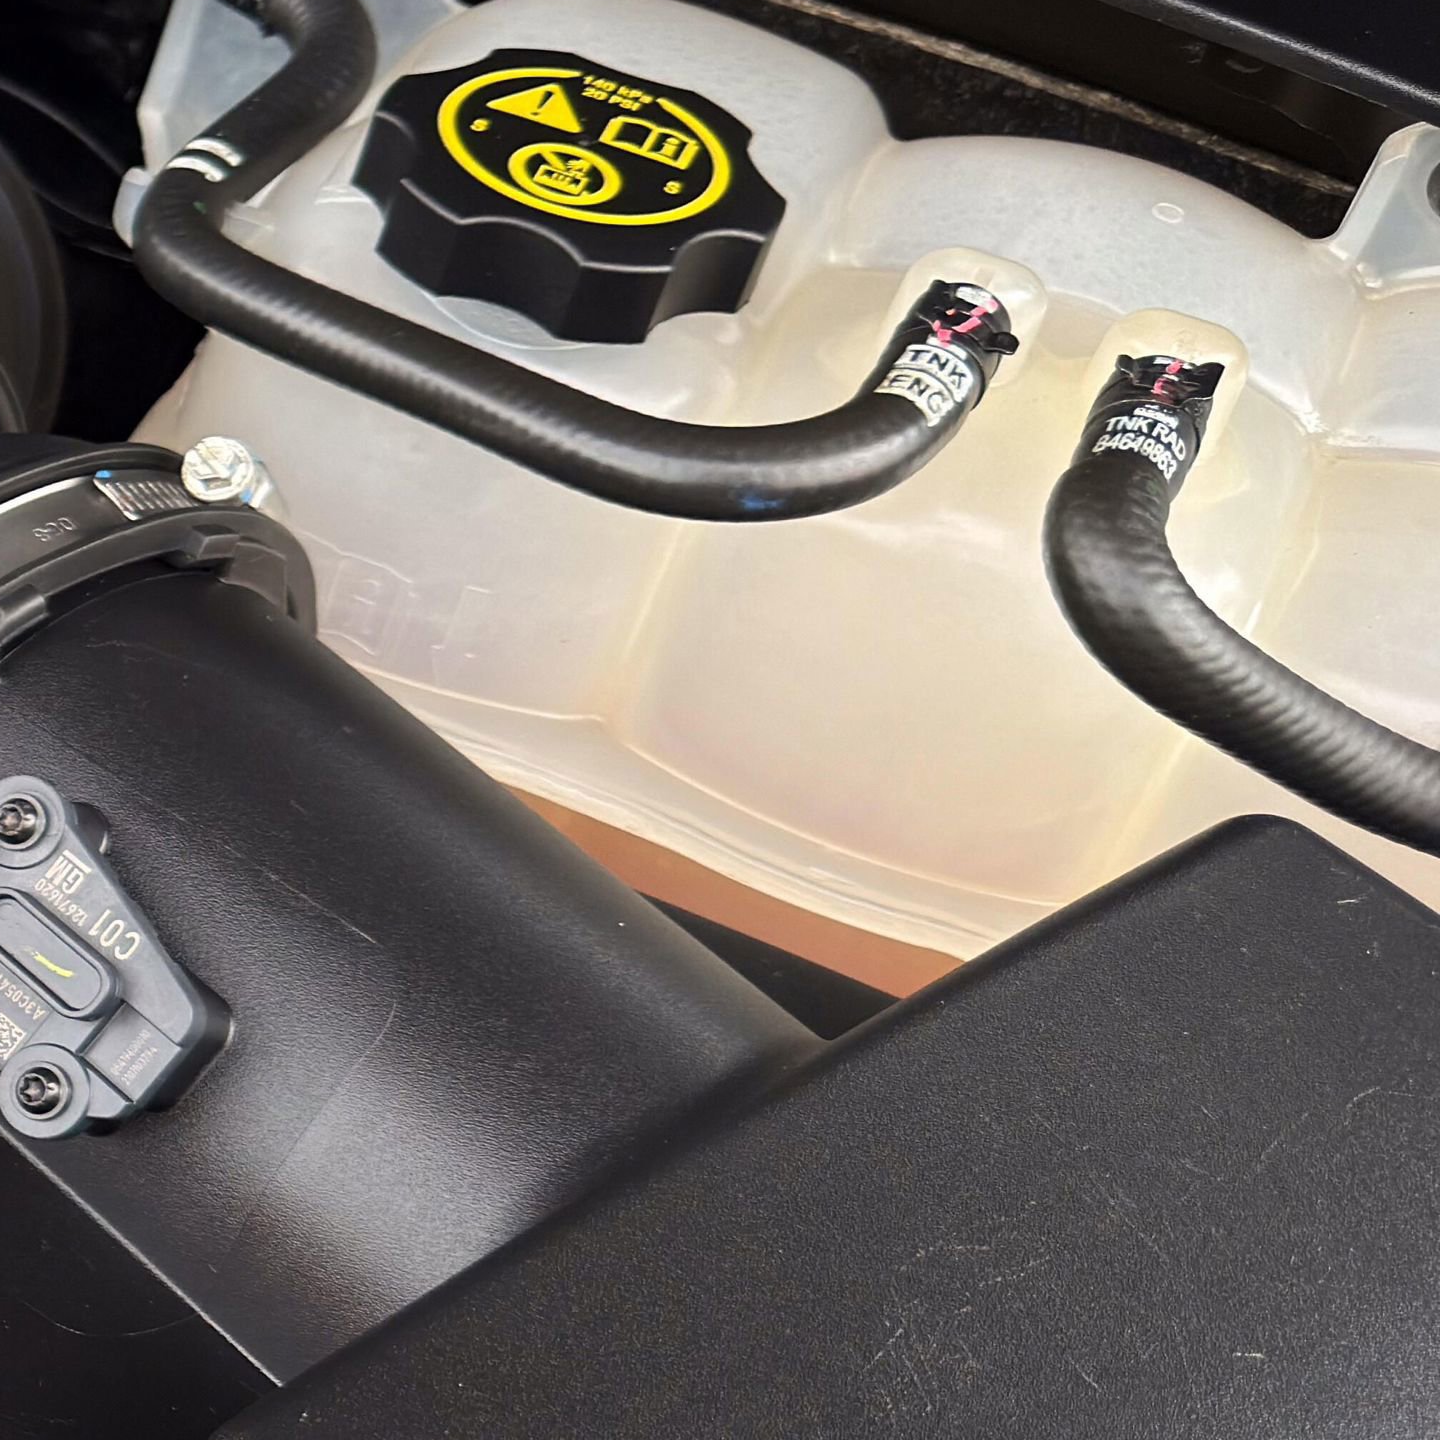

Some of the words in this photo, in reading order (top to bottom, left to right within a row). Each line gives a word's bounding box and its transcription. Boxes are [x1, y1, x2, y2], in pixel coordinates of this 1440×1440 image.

[581, 73, 618, 93] 140
[581, 87, 608, 101] 20
[608, 93, 643, 111] PSI
[907, 349, 967, 390] TNK
[1105, 415, 1154, 434] TNK
[1152, 422, 1188, 462] RAD
[44, 851, 89, 896] GM
